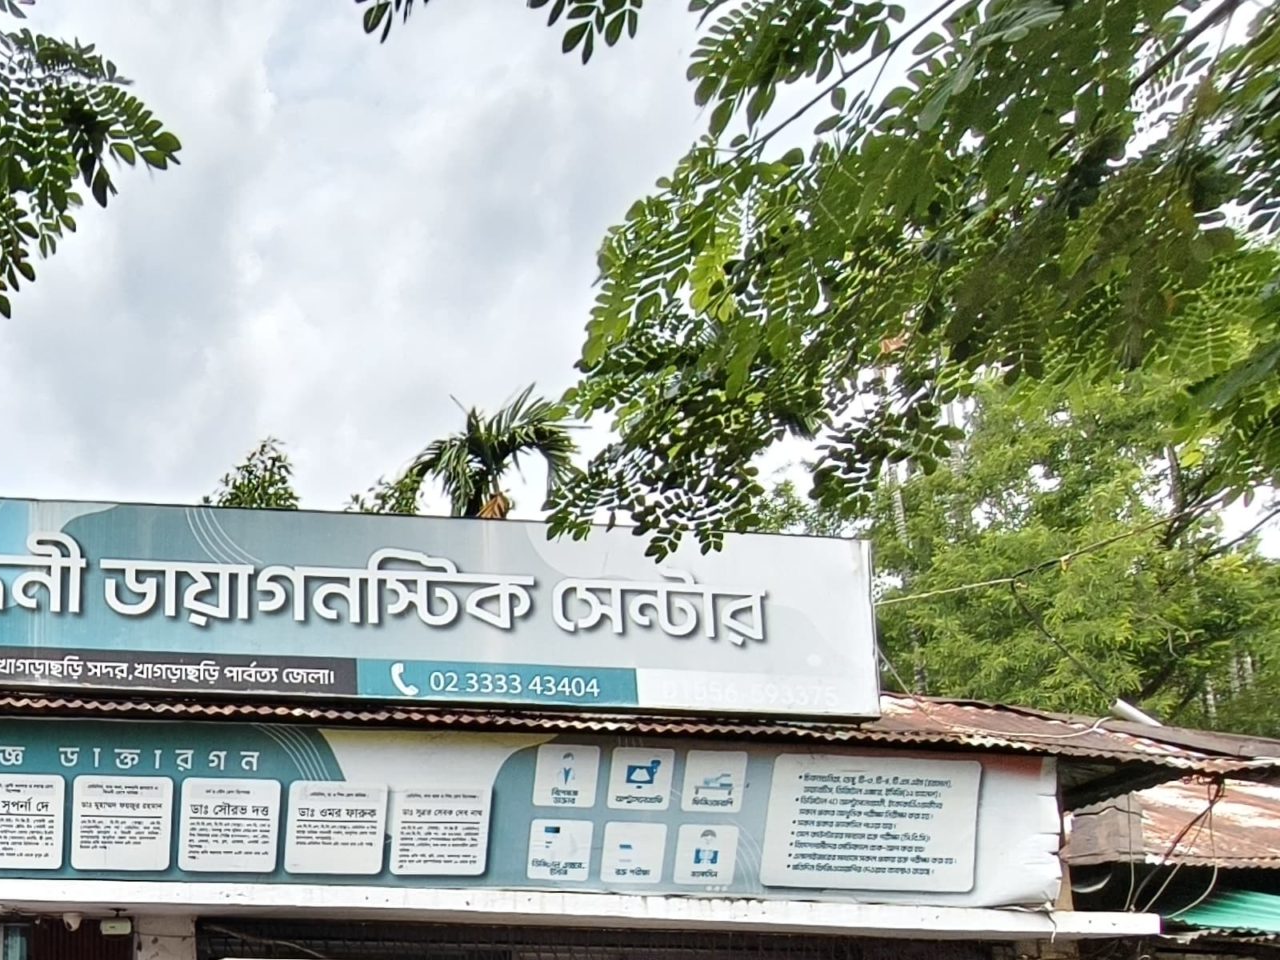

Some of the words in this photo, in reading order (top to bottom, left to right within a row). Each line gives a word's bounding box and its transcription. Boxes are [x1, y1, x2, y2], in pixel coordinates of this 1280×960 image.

[100, 547, 535, 629] ডায়াগনস্টিক
[552, 568, 767, 644] সেন্টার
[224, 662, 278, 684] পার্বত্য
[430, 672, 459, 691] 02
[465, 673, 522, 694] 3333
[527, 675, 600, 697] 43404
[36, 801, 50, 811] দে
[213, 802, 248, 816] সৌরভ
[252, 806, 270, 817] দত্ত
[319, 808, 341, 818] ওমর
[345, 808, 377, 819] ফারুক
